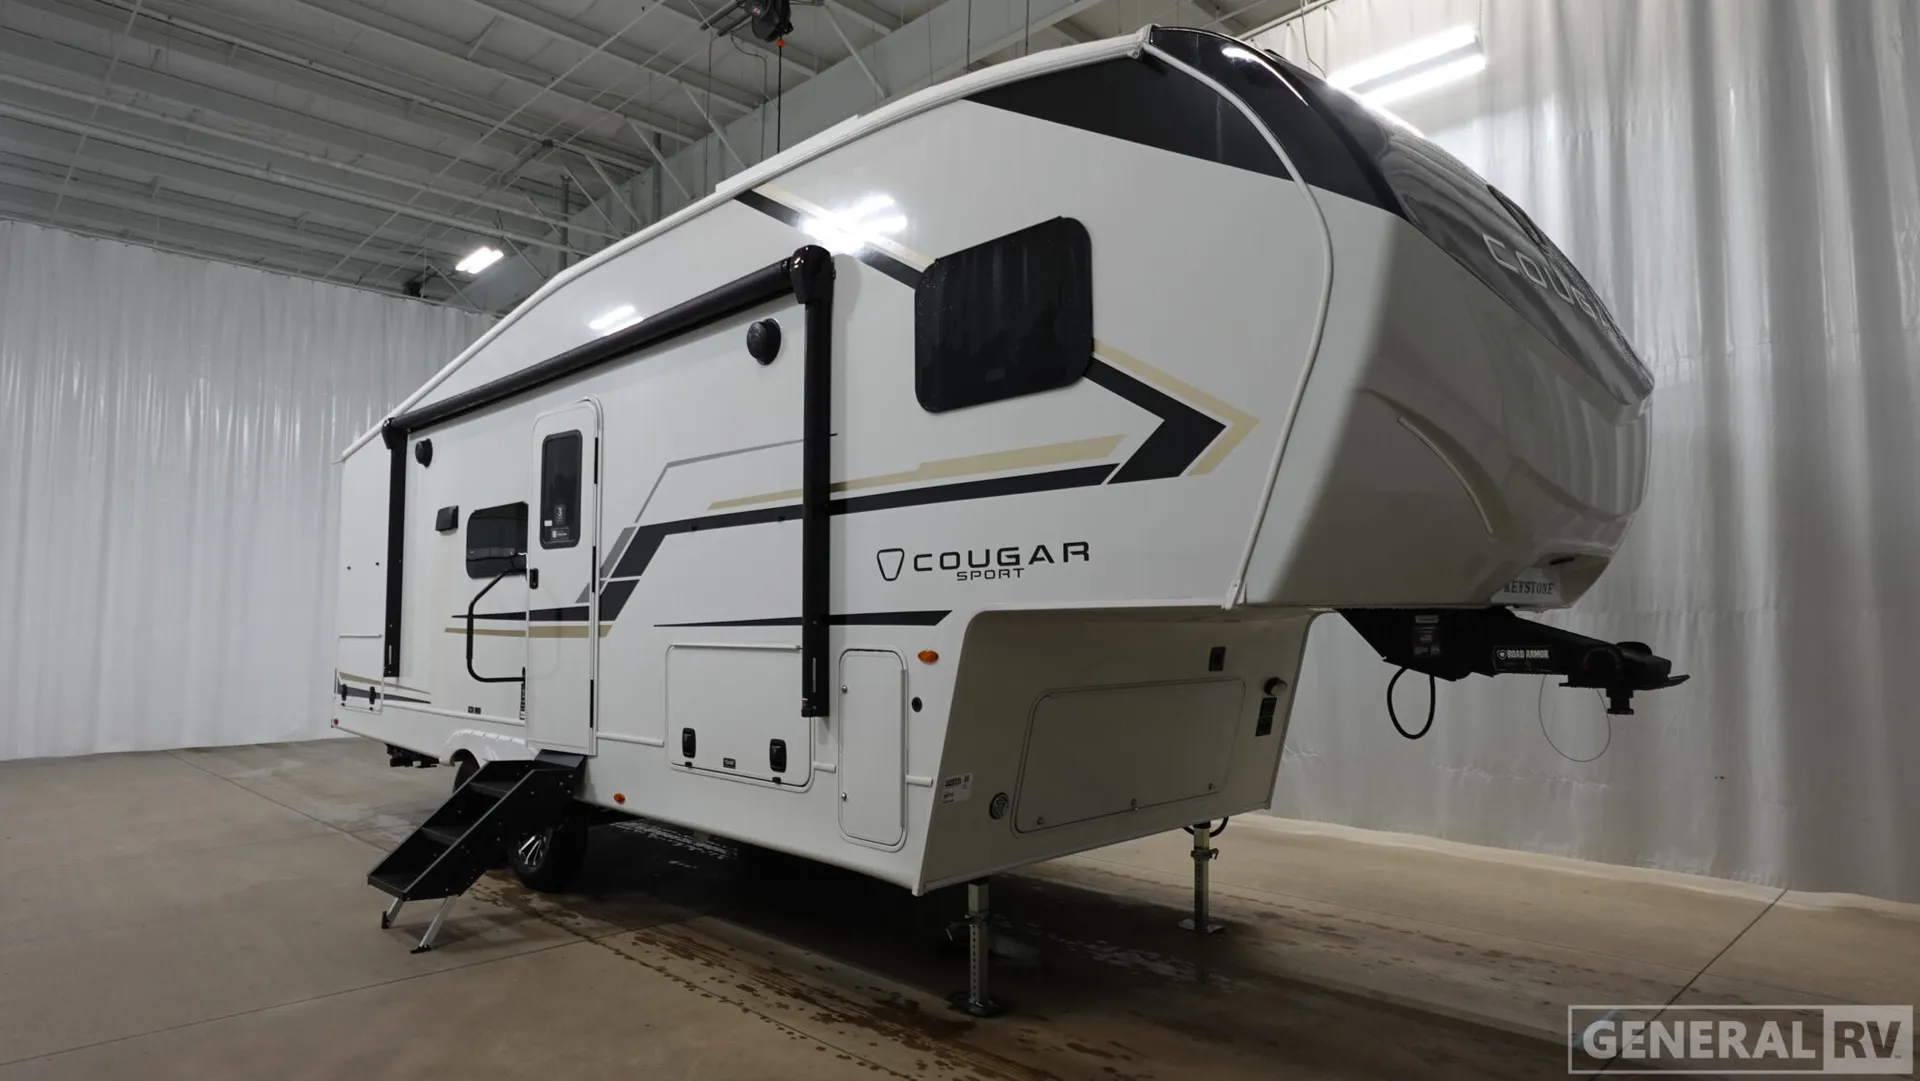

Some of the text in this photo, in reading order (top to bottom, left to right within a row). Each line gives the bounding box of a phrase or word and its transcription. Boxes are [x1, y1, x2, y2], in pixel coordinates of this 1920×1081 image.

[913, 541, 1090, 572] COUGAR
[956, 567, 1025, 581] SPORT
[1507, 650, 1550, 659] ROAD ARMOR
